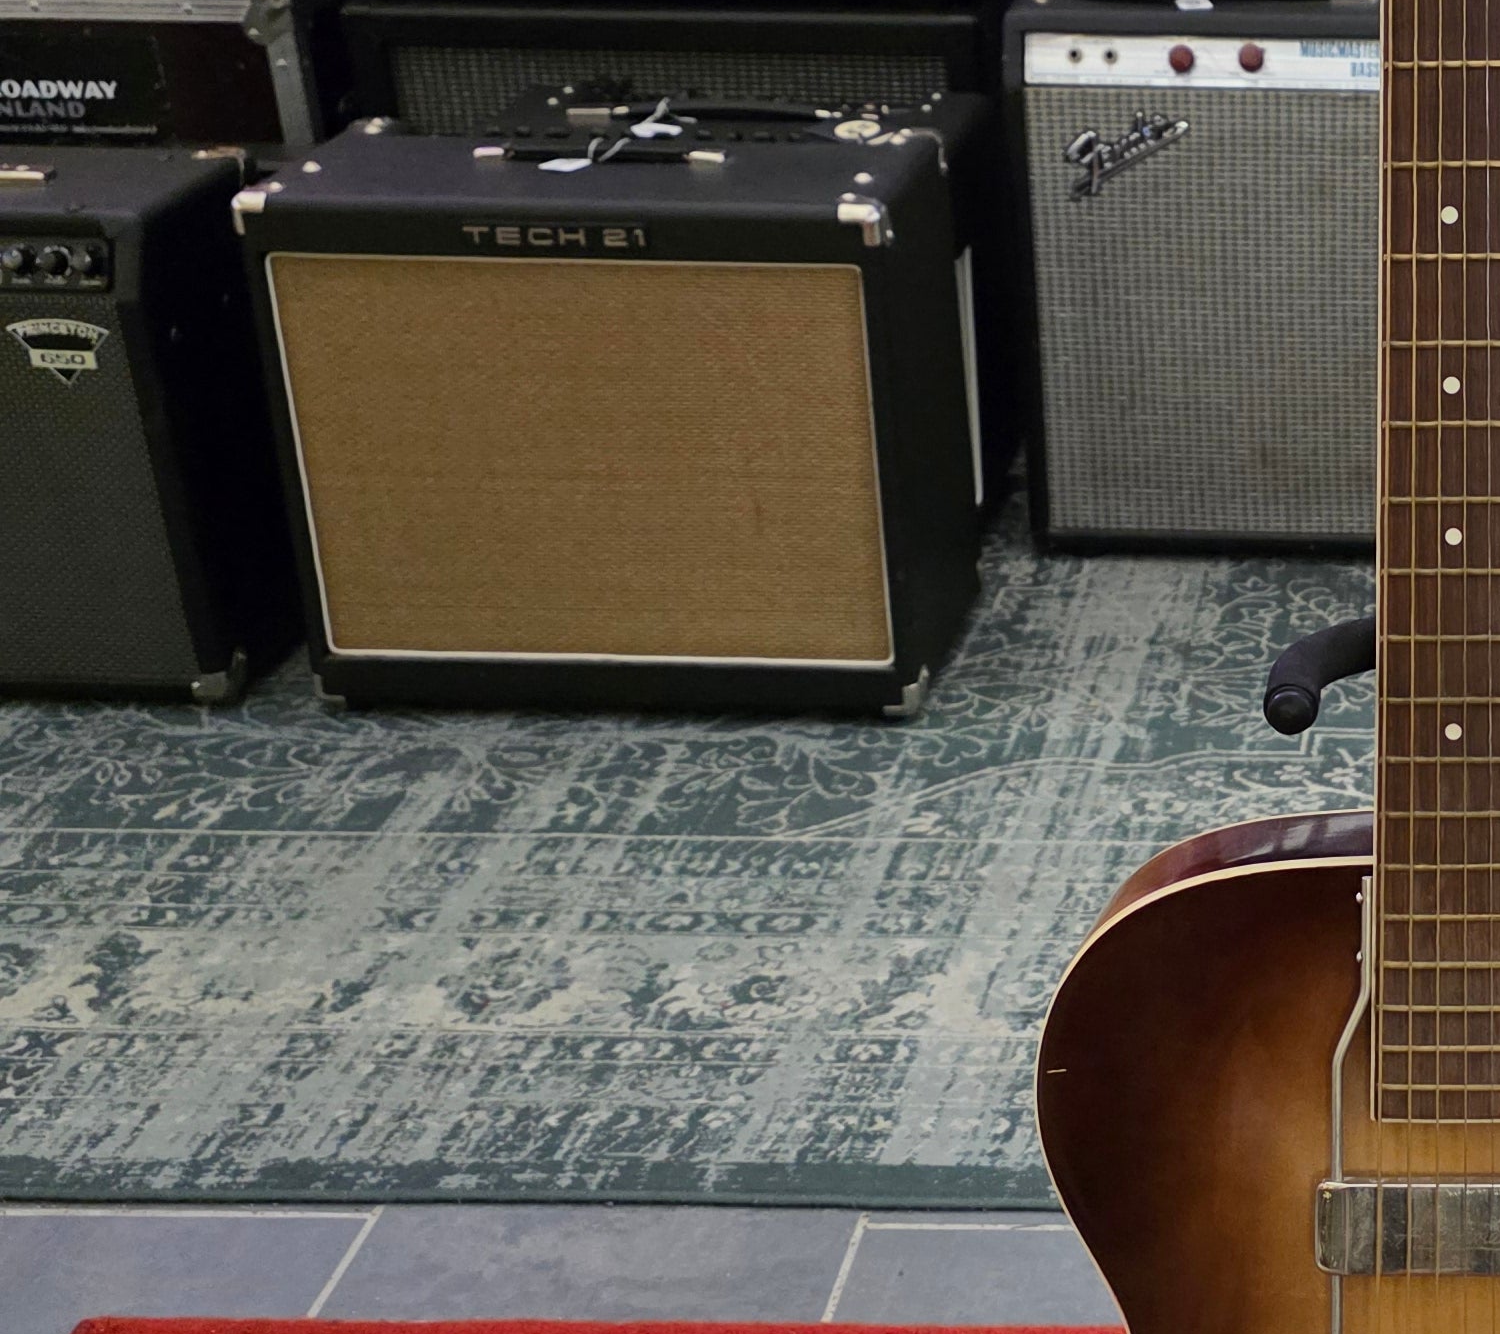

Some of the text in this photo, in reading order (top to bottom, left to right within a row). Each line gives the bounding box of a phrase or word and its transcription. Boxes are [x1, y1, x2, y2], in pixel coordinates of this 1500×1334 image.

[0, 78, 118, 100] OADWAY
[462, 225, 647, 247] TECH 21
